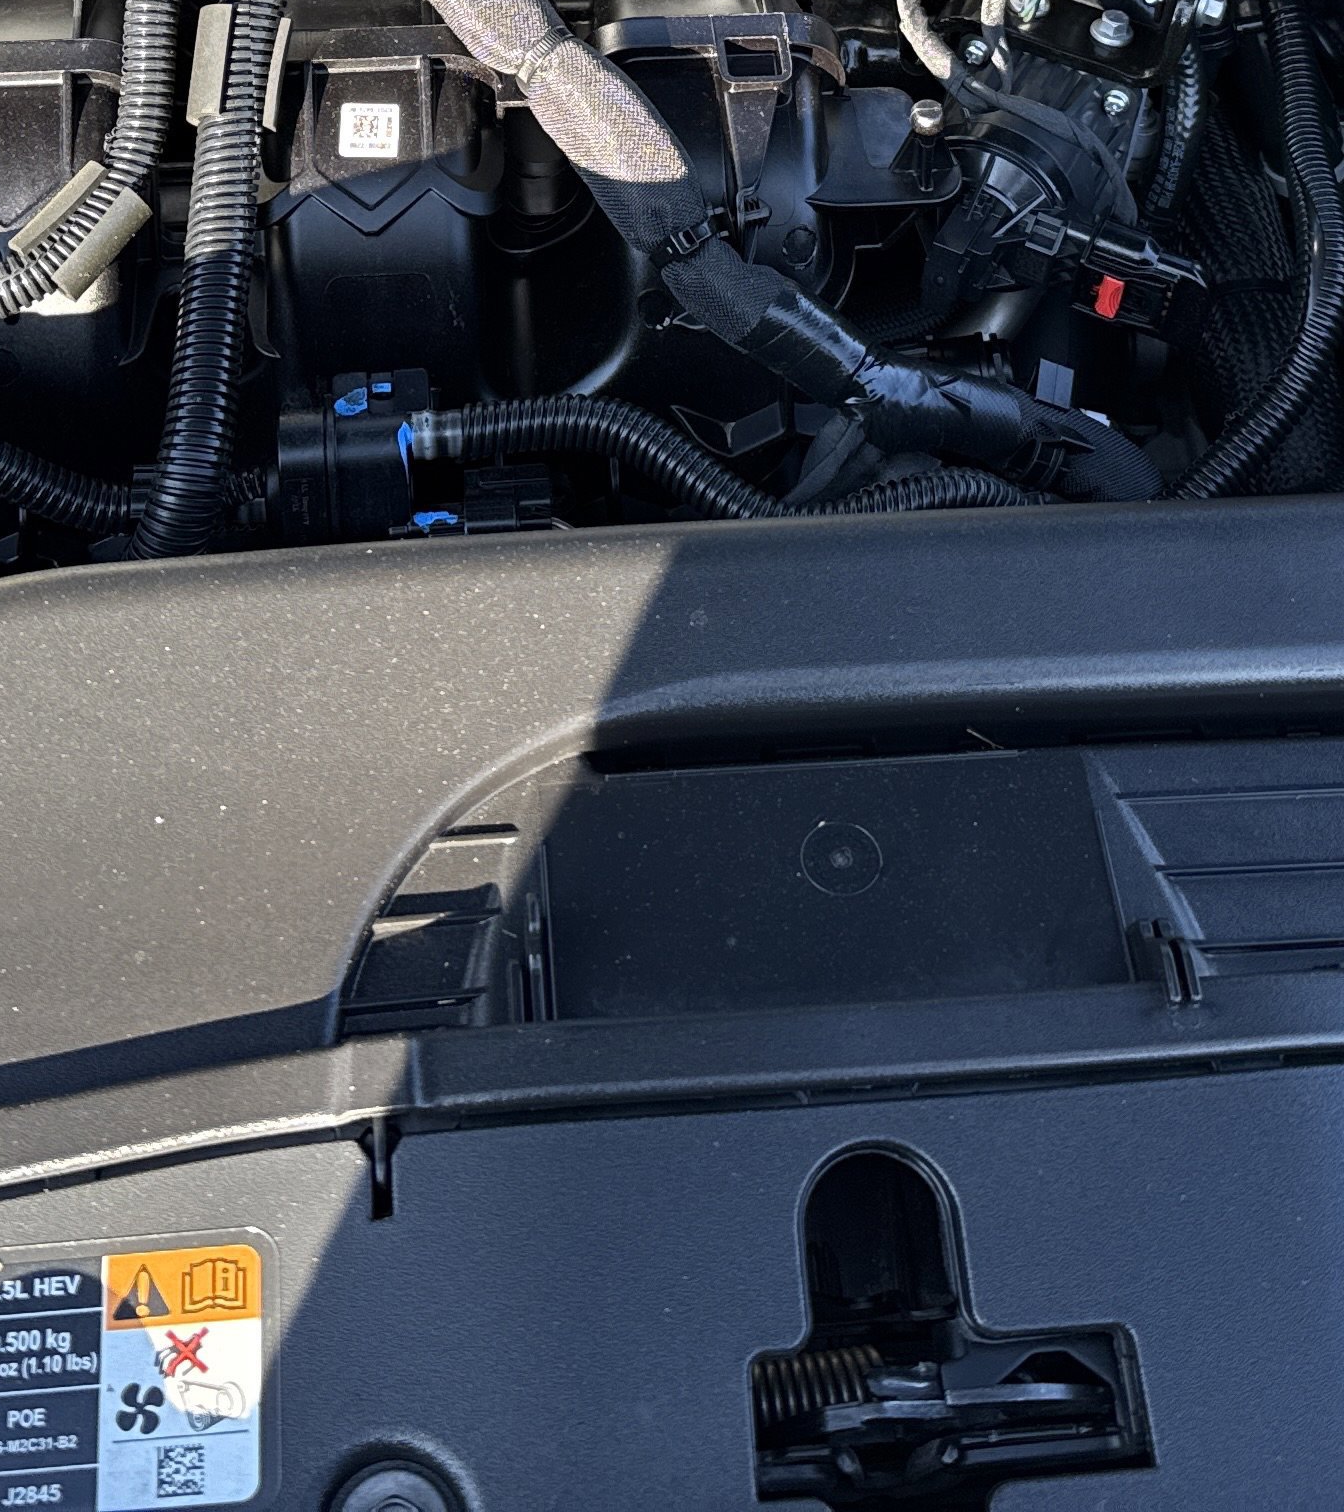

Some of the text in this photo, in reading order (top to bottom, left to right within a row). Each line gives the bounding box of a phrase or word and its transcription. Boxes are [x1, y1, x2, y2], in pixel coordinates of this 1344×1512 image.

[32, 1274, 81, 1297] HEV
[45, 1328, 71, 1353] kg
[21, 1354, 62, 1379] (1.10
[66, 1352, 97, 1373] lbs)
[7, 1408, 47, 1428] POE
[1, 1484, 62, 1508] J2845
